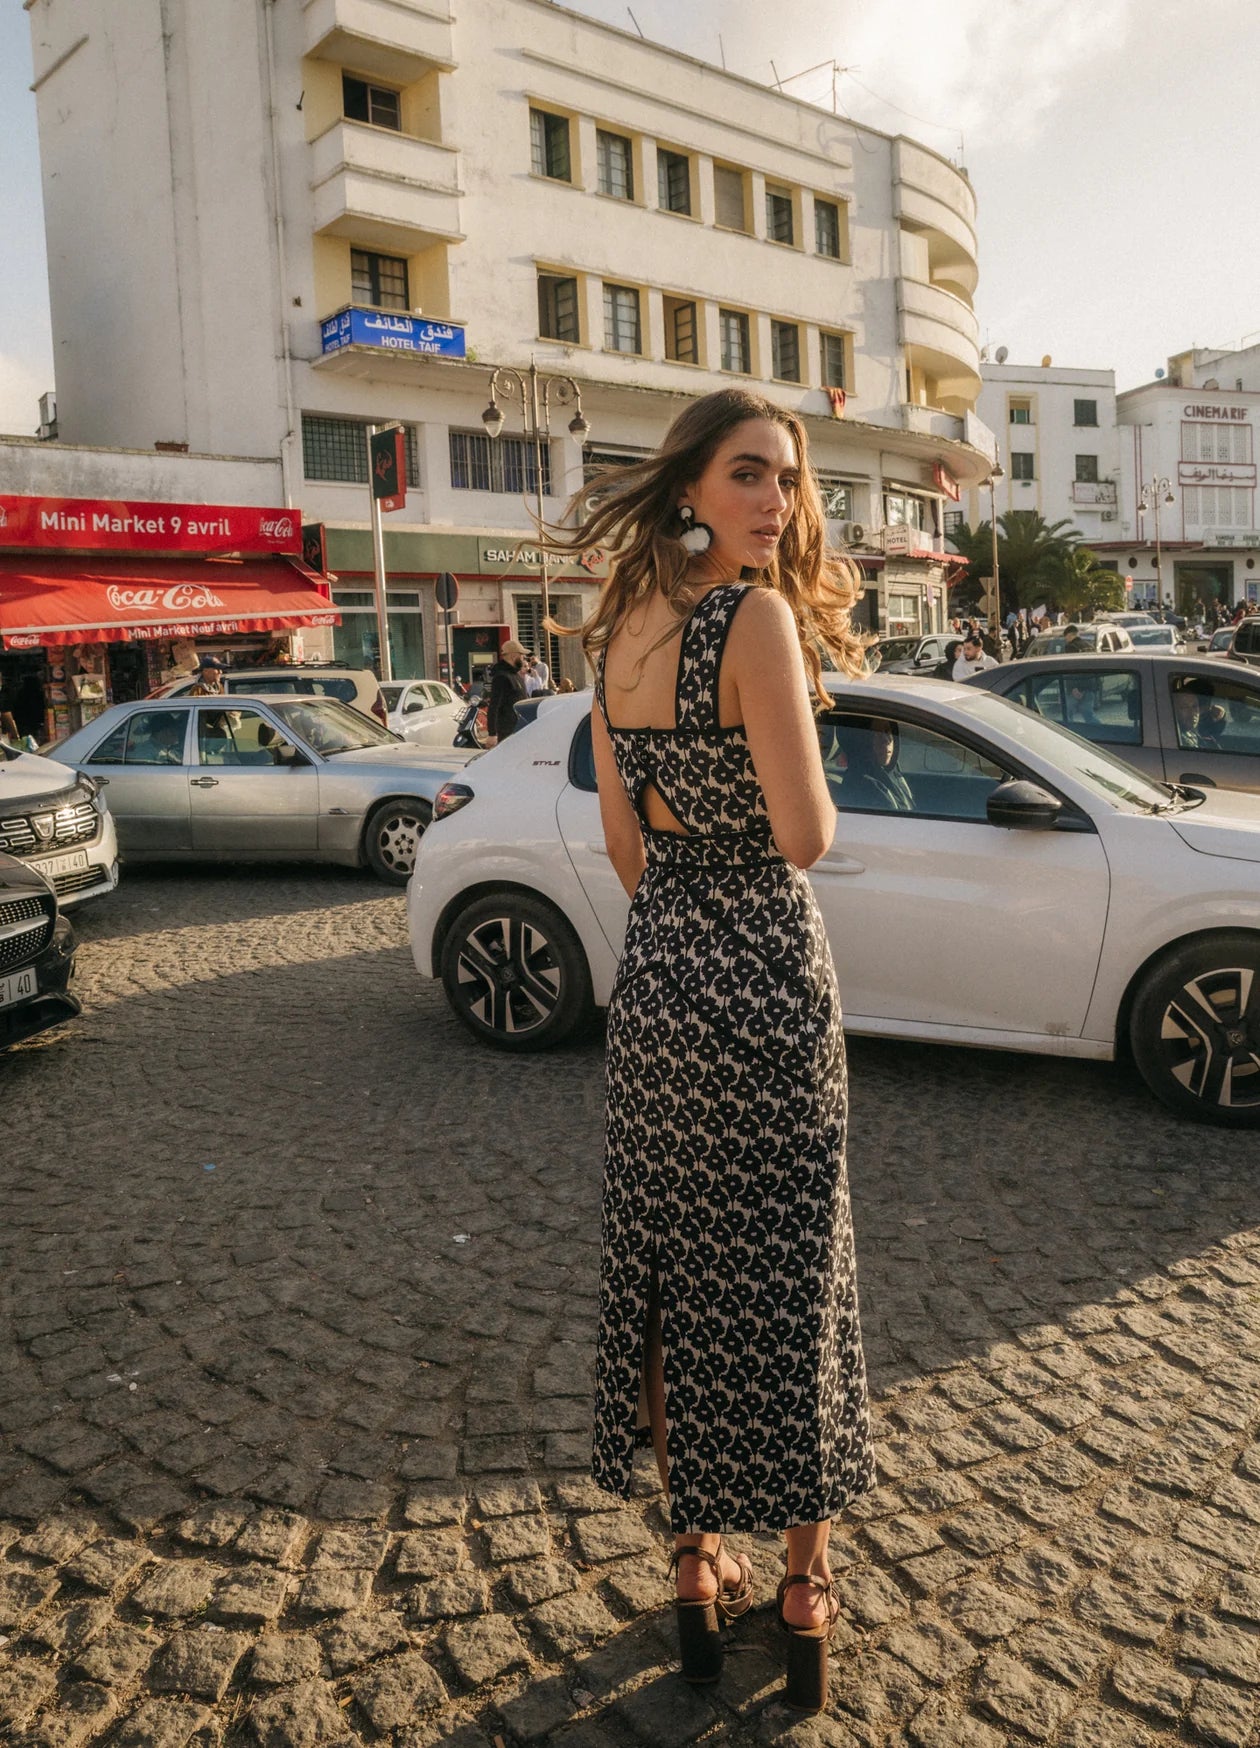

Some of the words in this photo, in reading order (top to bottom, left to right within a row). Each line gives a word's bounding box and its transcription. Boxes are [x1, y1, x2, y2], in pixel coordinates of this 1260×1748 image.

[420, 324, 454, 341] فندق
[381, 335, 417, 350] HOTEL
[418, 341, 441, 353] TAIF
[41, 511, 86, 531] Mini
[92, 513, 166, 534] Market
[170, 516, 182, 534] 9
[187, 518, 232, 536] avril
[887, 536, 908, 544] HOTEL
[487, 549, 536, 563] SAHAM
[106, 583, 225, 611] Coca-Cola
[128, 628, 151, 640] Mini
[153, 624, 191, 637] Market
[216, 621, 238, 633] avril
[73, 854, 84, 868] 40
[17, 974, 31, 995] 40
